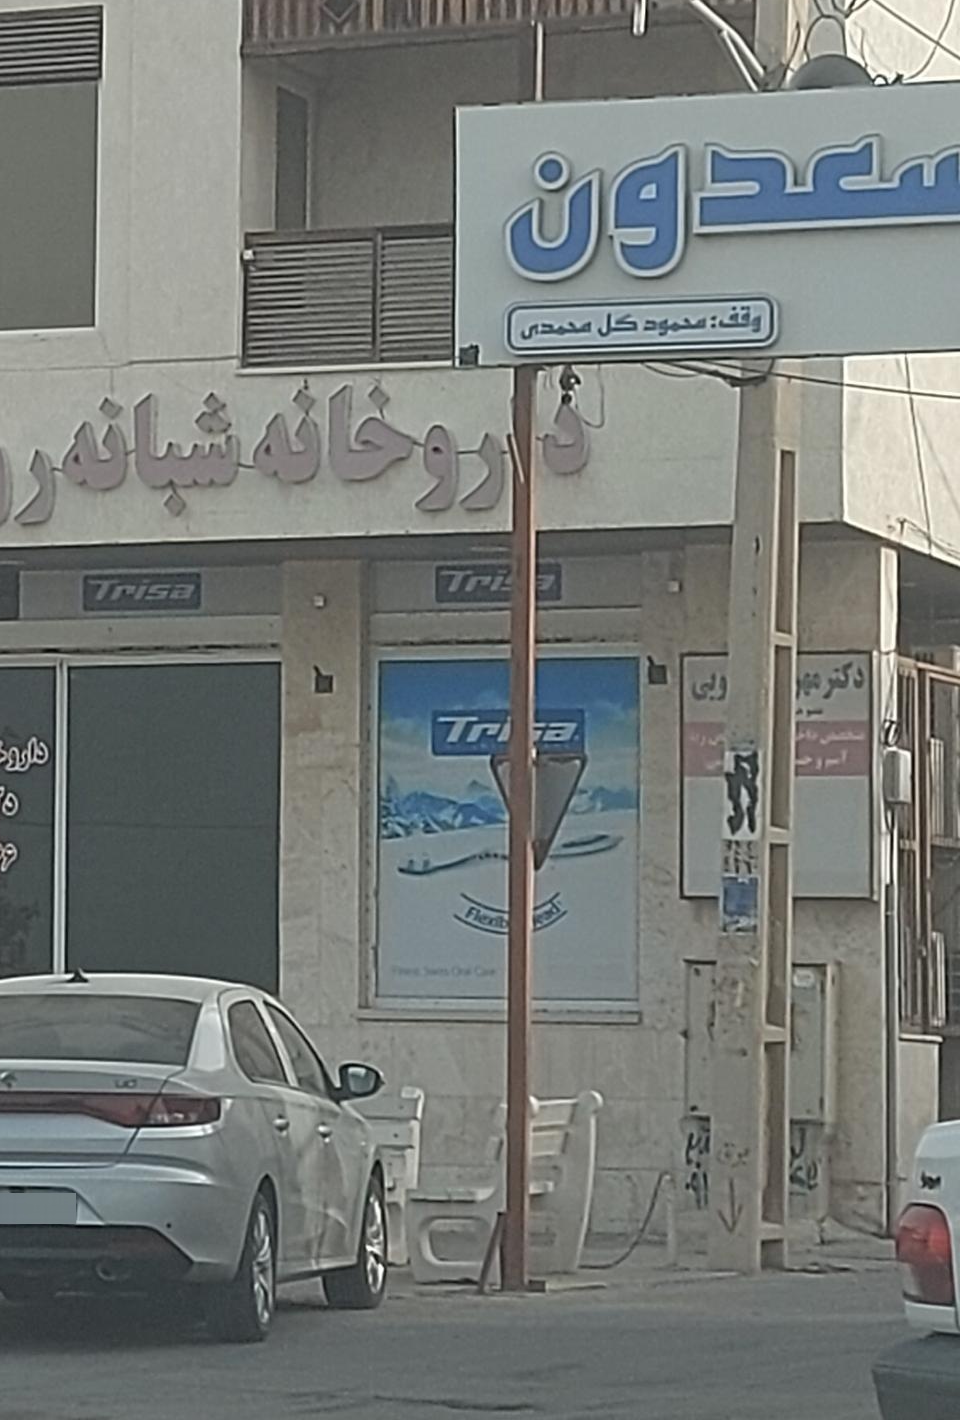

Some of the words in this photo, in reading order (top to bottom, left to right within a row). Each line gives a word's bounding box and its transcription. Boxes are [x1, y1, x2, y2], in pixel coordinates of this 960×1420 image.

[643, 317, 707, 337] محمود
[61, 391, 241, 517] شبانه
[251, 384, 591, 512] دروخانه
[87, 579, 195, 600] Trisa
[822, 660, 865, 700] دکتر
